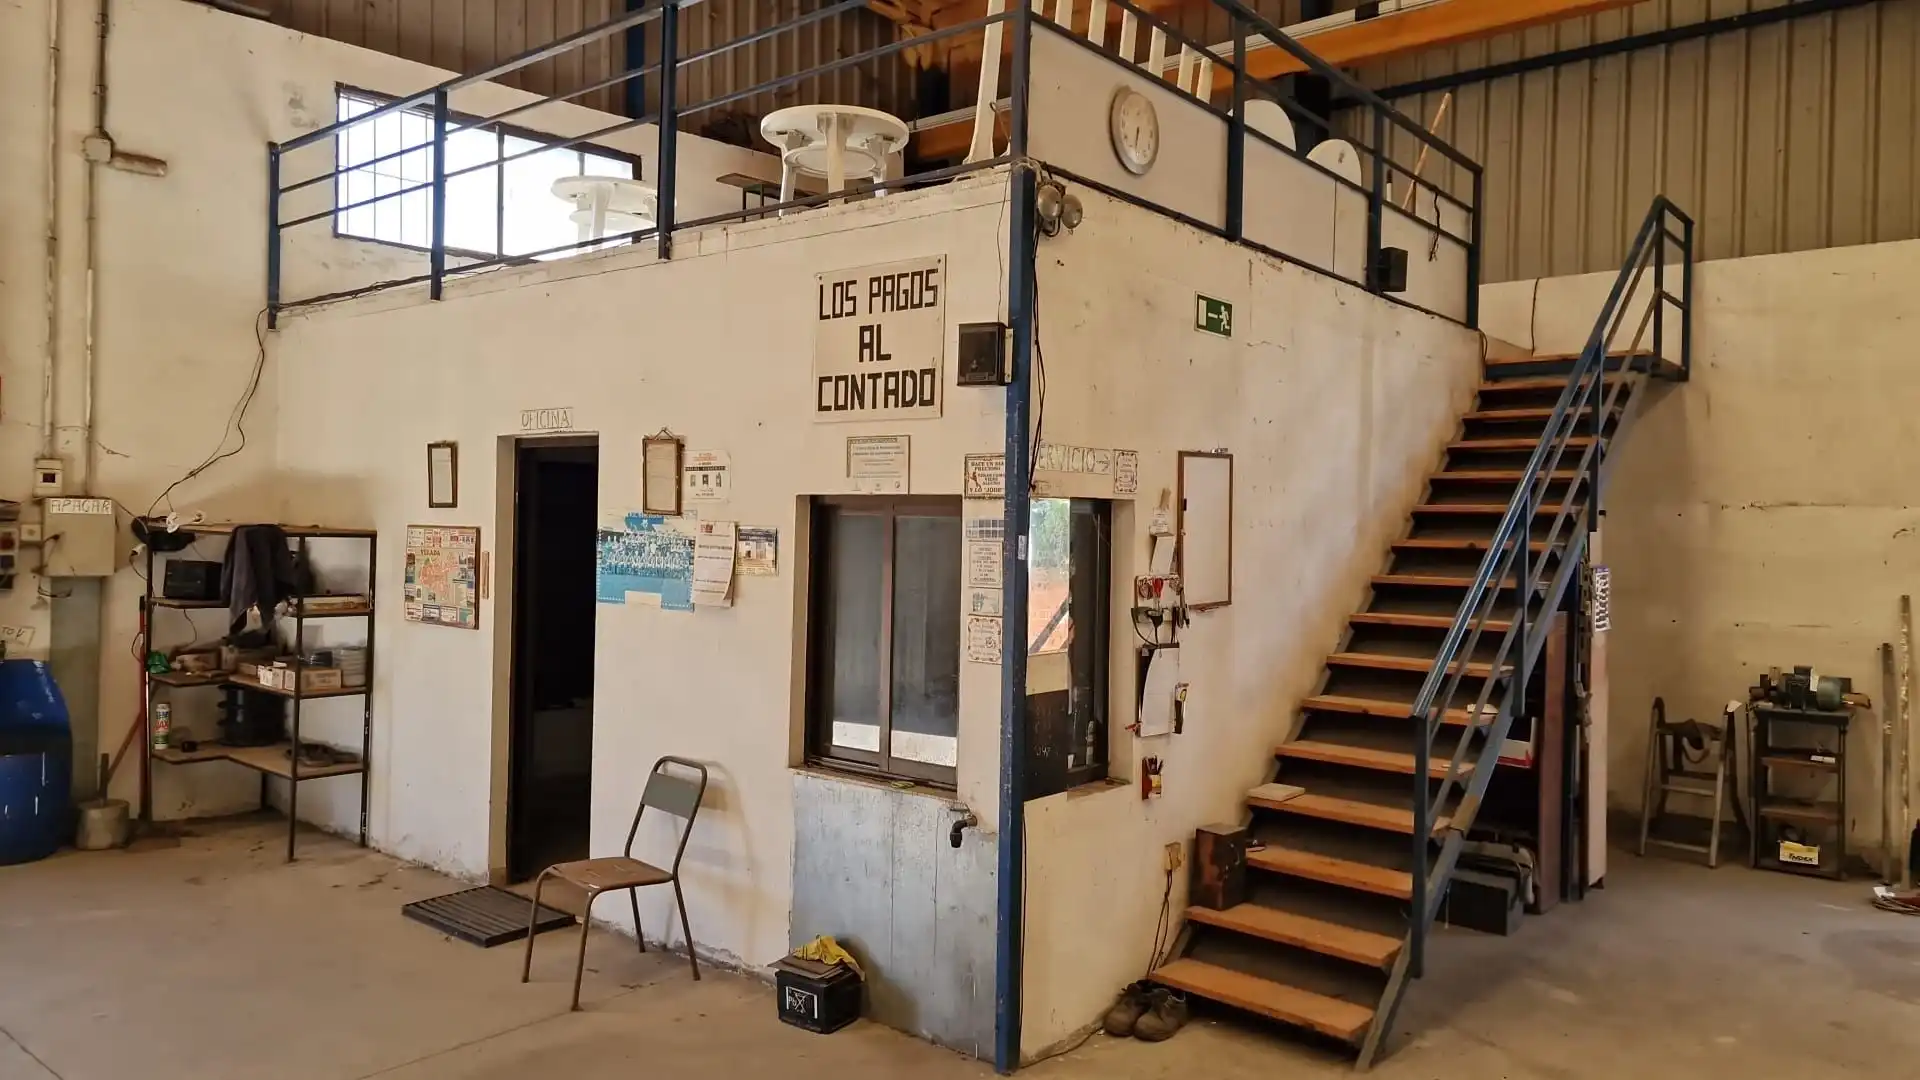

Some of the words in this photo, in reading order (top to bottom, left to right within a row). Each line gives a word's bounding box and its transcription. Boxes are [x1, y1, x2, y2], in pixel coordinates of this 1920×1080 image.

[819, 279, 858, 321] LOS
[868, 267, 939, 315] PAGOS
[858, 323, 892, 363] AL
[817, 367, 936, 412] CONTADO
[521, 409, 570, 430] OFICINA
[1038, 444, 1096, 473] ERVICIO
[51, 499, 111, 514] APAGAR
